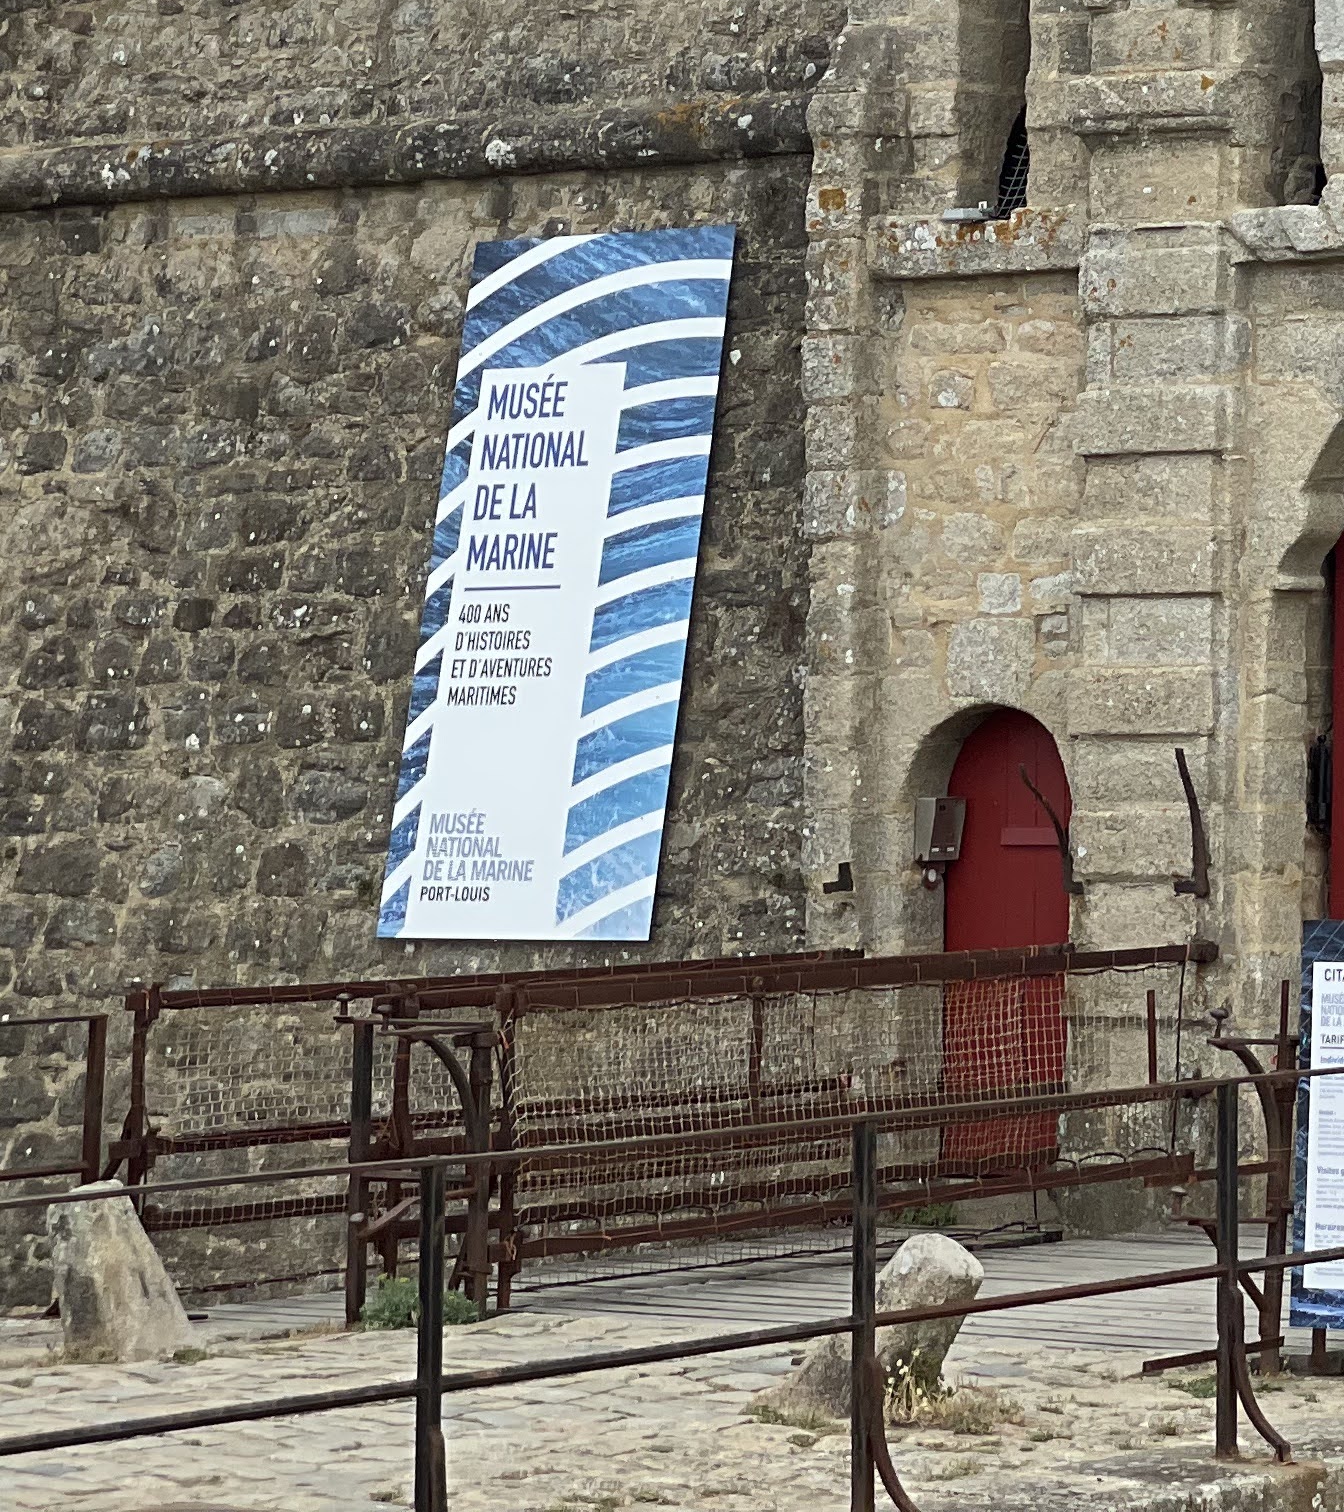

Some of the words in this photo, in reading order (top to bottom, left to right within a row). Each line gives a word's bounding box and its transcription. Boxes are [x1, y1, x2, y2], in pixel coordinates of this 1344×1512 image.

[488, 373, 569, 420] MUSÉE
[480, 430, 589, 471] NATIONAL
[473, 484, 505, 521] DE
[509, 483, 537, 520] LA
[466, 532, 558, 571] MARINE
[459, 604, 482, 624] 400
[484, 604, 510, 623] ANS
[455, 630, 531, 651] D'HISTOIRES
[451, 659, 466, 679] ET
[468, 657, 553, 679] D'AVENTURES
[447, 686, 517, 706] MARITIMES
[429, 808, 487, 835] MUSÉE
[426, 836, 503, 858] NATIONAL
[422, 860, 444, 881] DE
[448, 860, 466, 881] LA
[471, 860, 535, 882] MARINE
[420, 886, 490, 902] PORT-LOUIS
[1321, 1016, 1331, 1027] DE
[1333, 1017, 1342, 1027] LA
